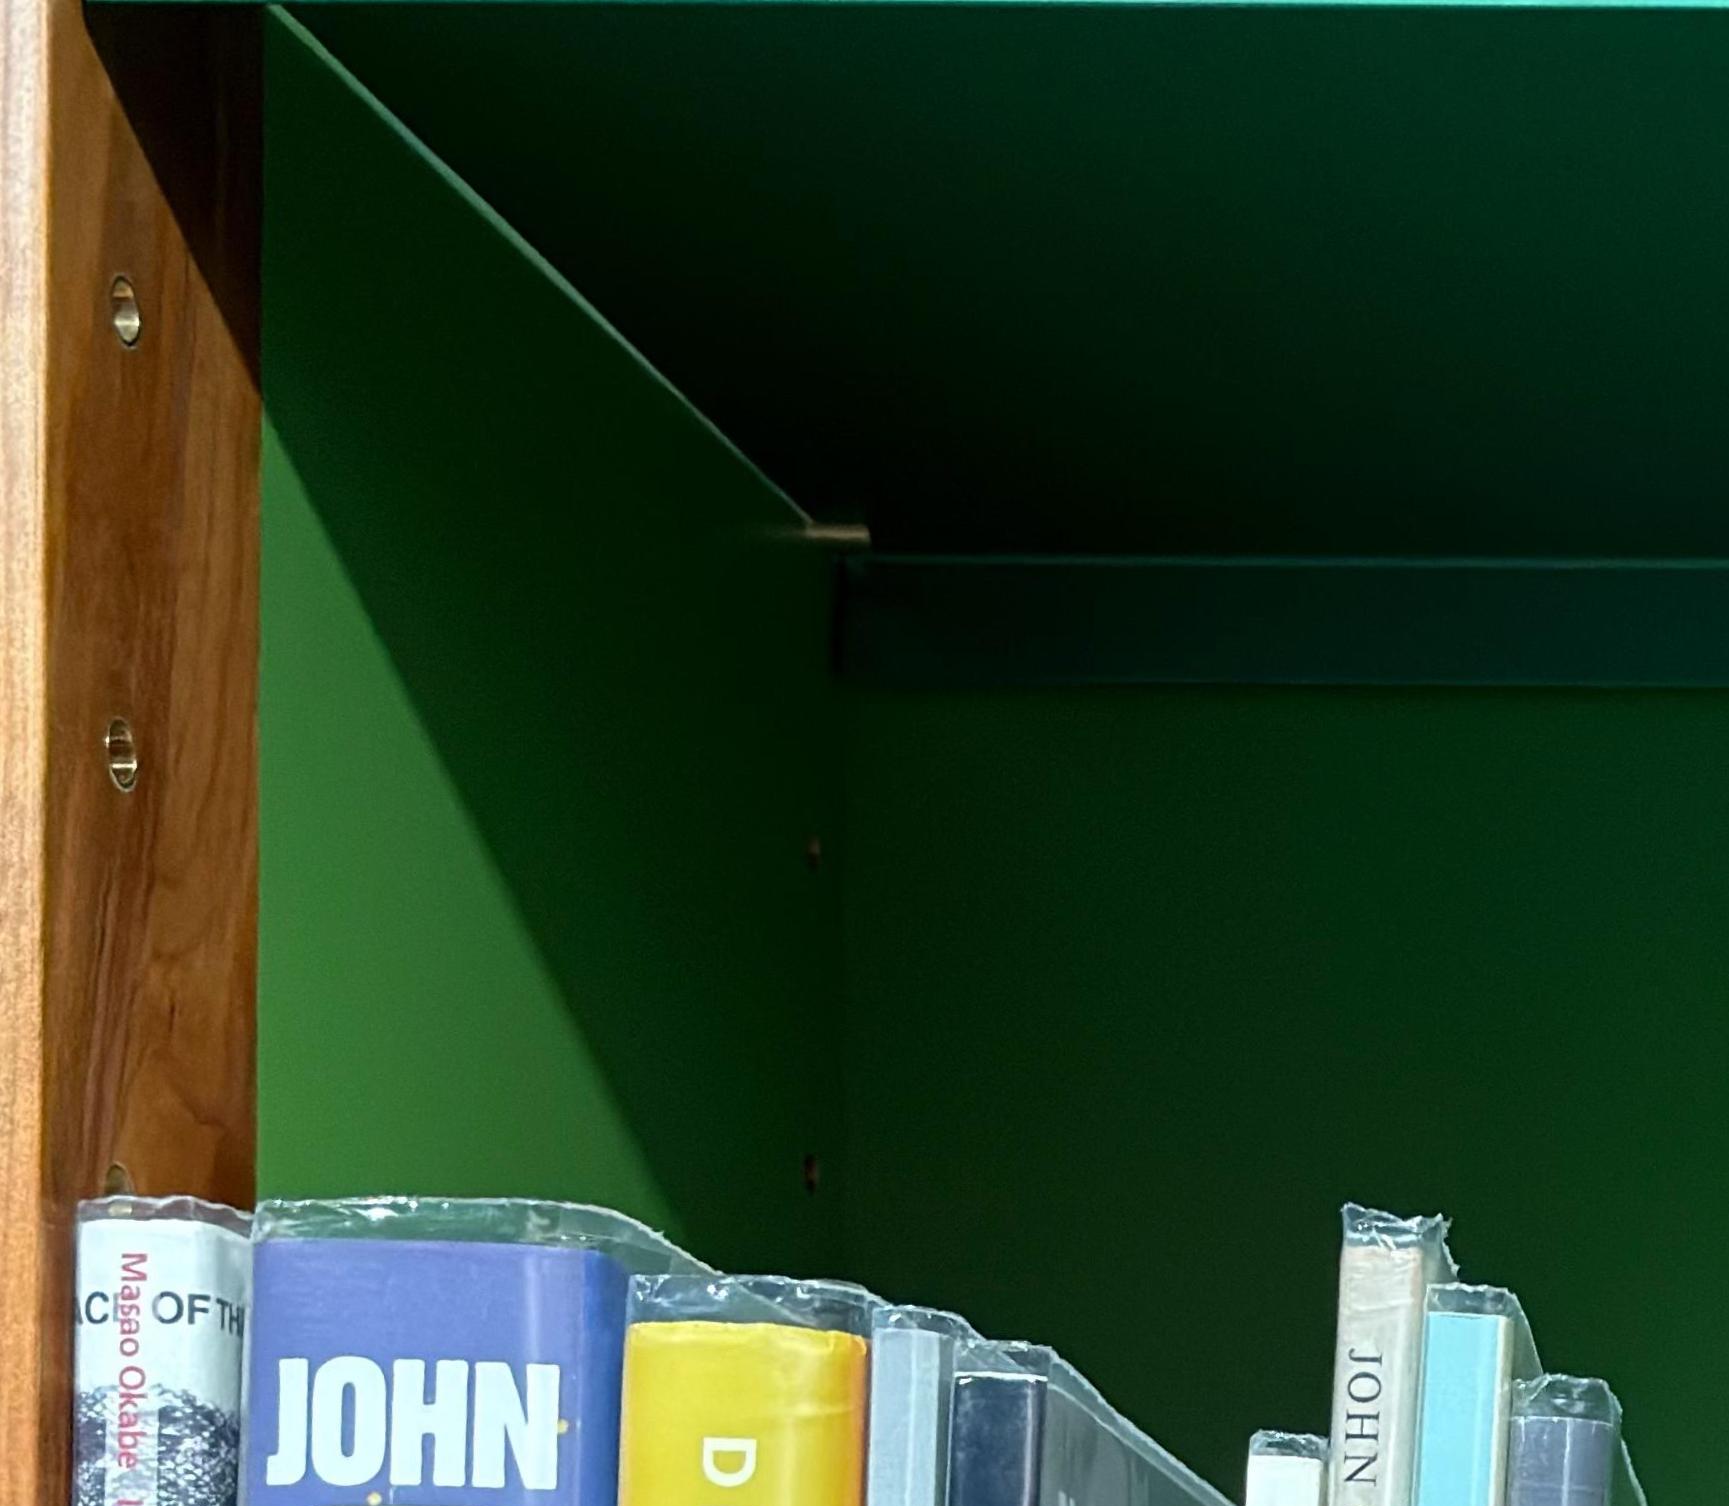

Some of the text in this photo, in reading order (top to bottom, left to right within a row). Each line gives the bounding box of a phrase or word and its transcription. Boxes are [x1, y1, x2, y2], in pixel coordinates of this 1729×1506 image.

[115, 1253, 148, 1470] Masao Okabe
[152, 1291, 211, 1325] OF
[216, 1298, 245, 1337] TH
[266, 1356, 561, 1491] JOHN
[1342, 1348, 1383, 1487] JOHN
